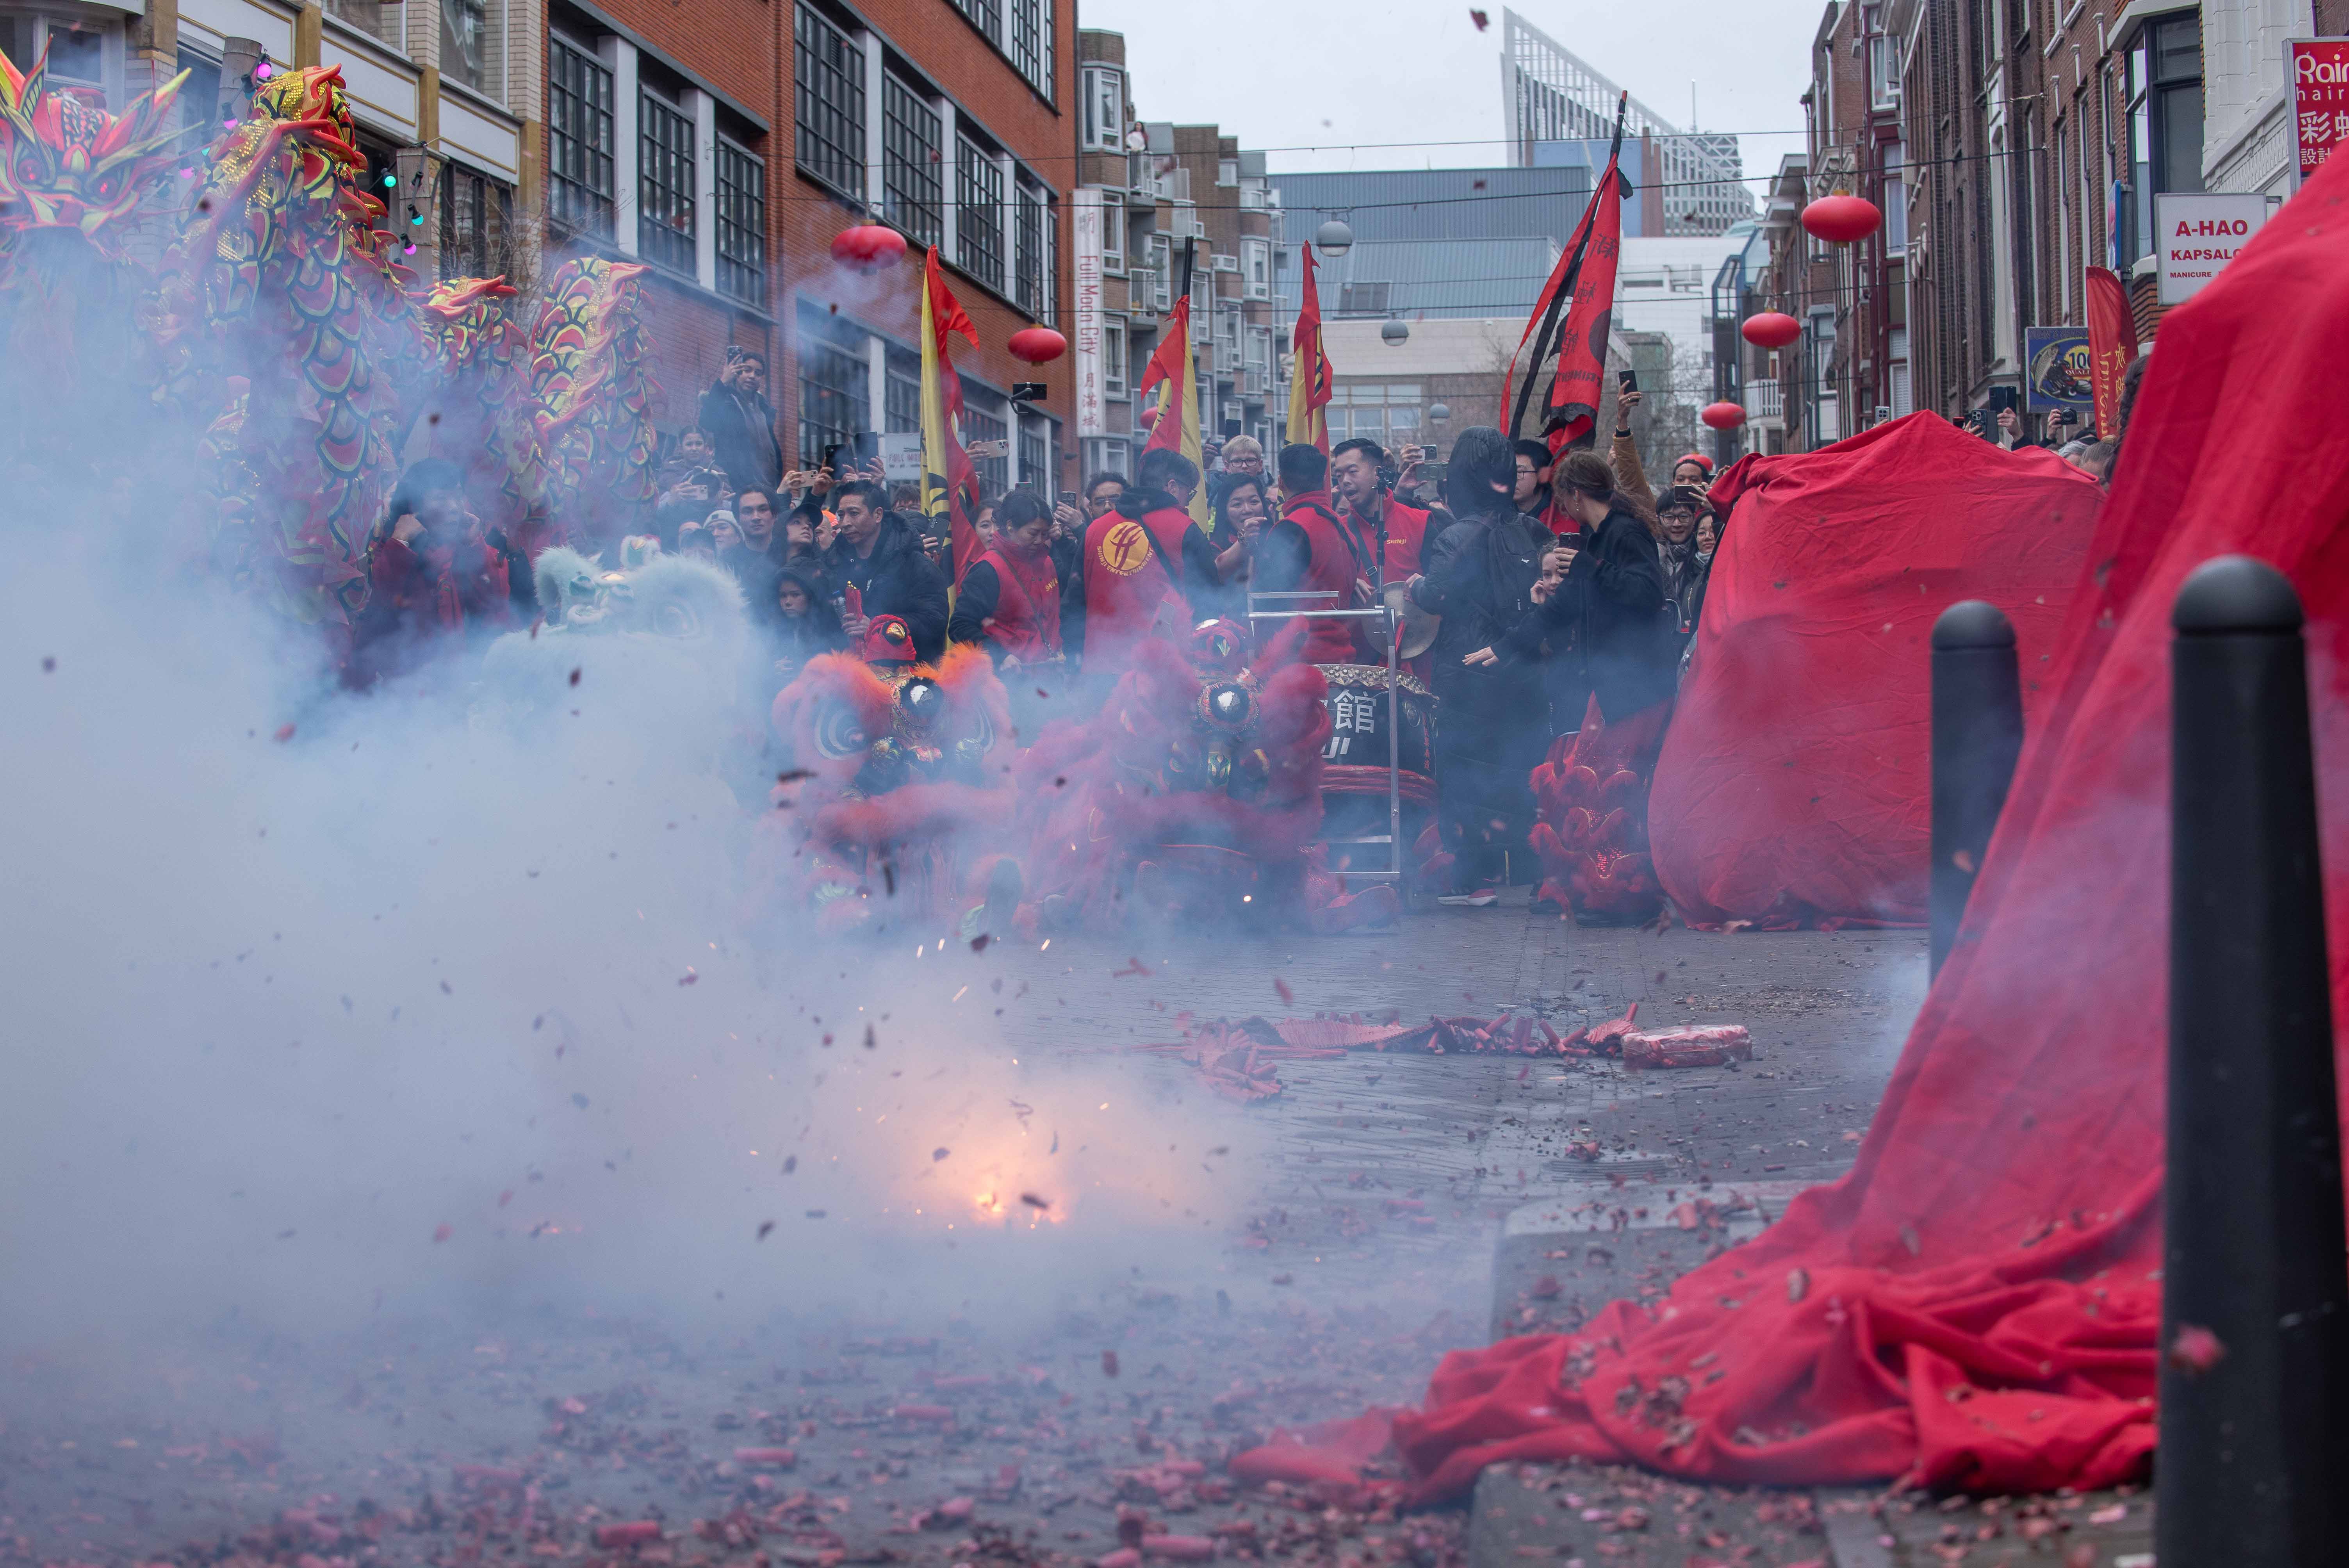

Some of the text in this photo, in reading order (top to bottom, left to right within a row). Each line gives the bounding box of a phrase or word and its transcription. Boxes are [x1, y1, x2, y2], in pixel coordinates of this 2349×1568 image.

[2296, 86, 2344, 101] hair
[2175, 220, 2248, 237] A-HAO
[1080, 256, 1098, 279] Full
[1080, 285, 1098, 322] Moon
[1078, 327, 1099, 355] City
[1097, 546, 1108, 567] SHINJI
